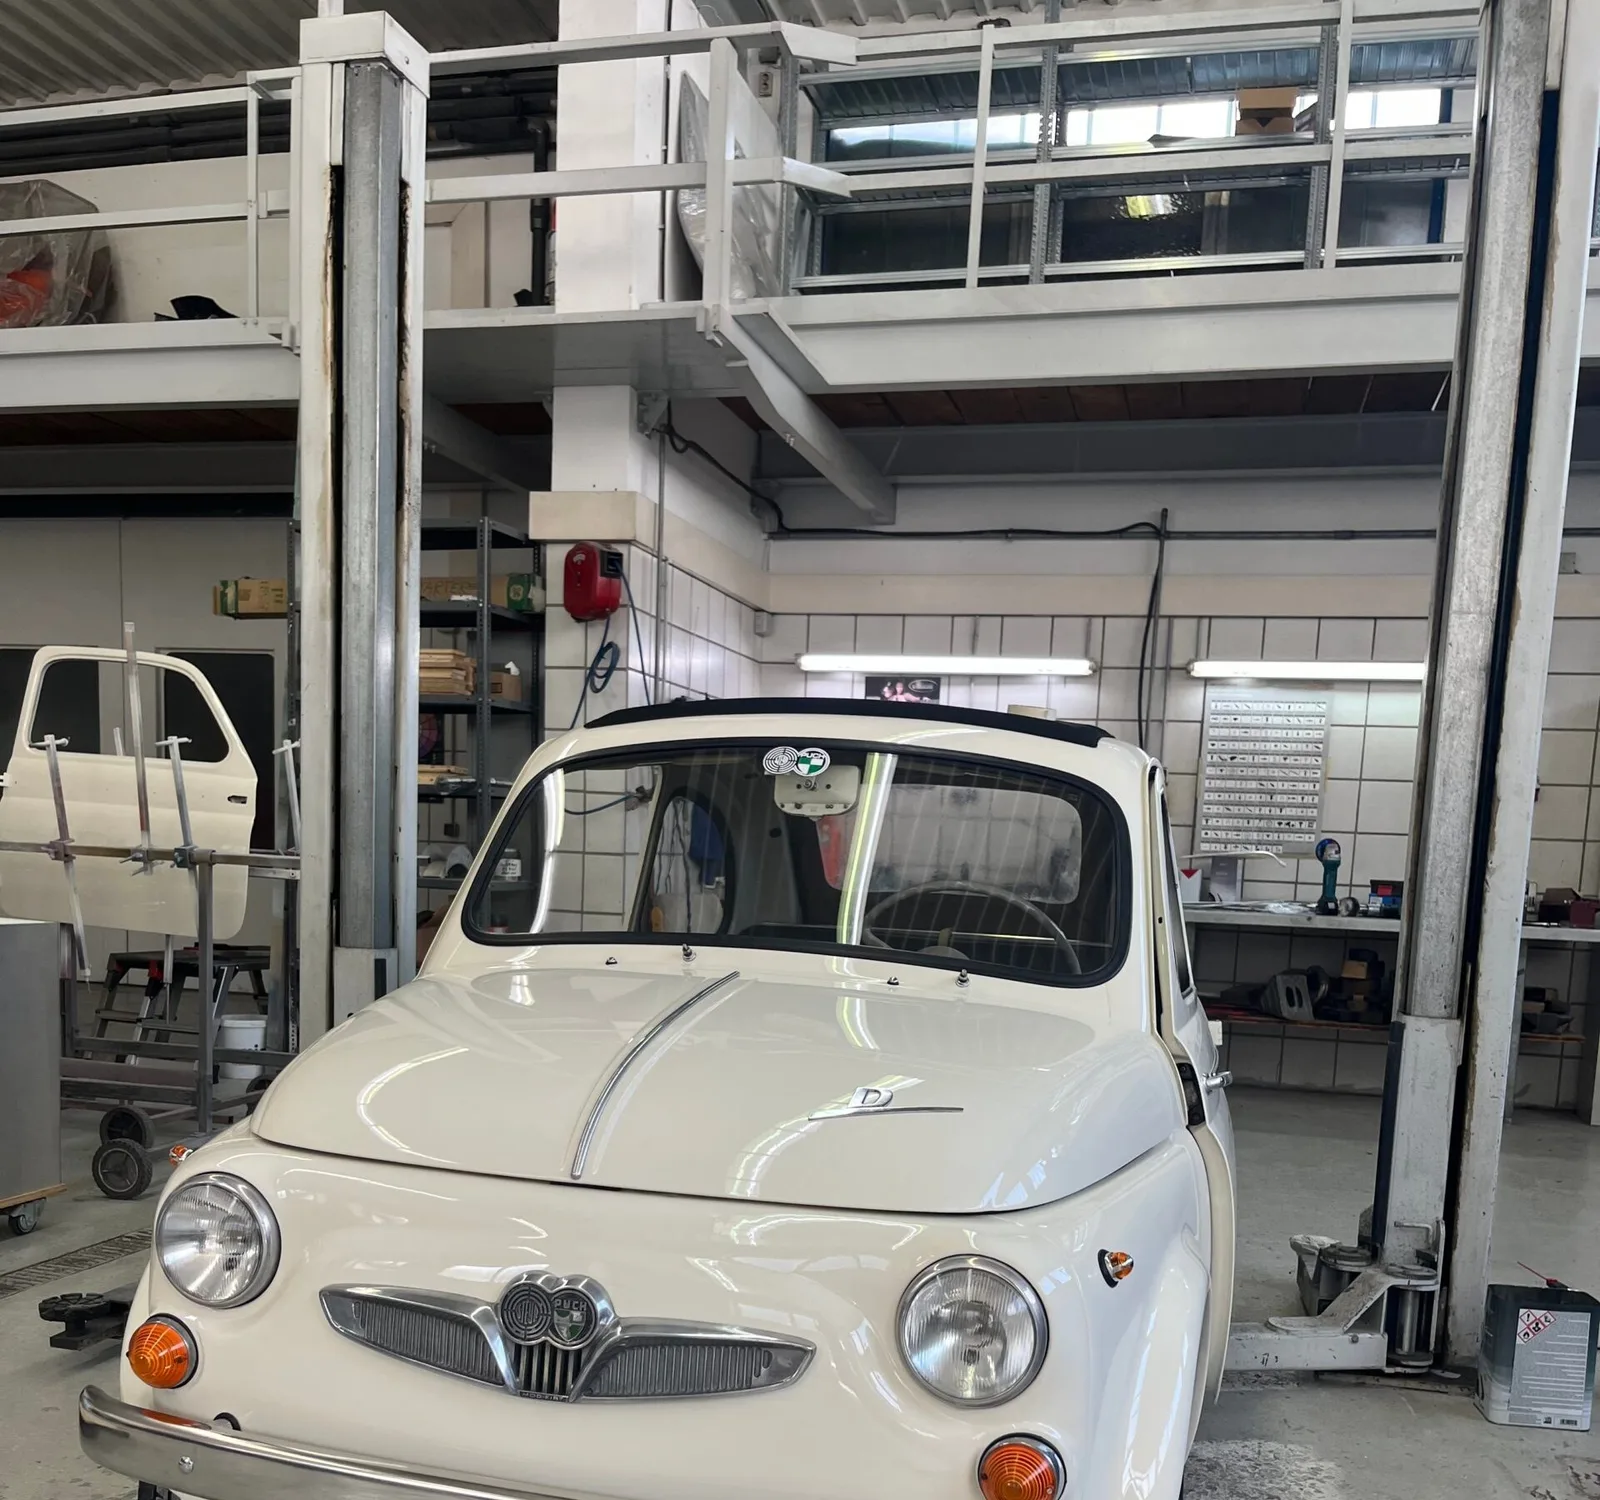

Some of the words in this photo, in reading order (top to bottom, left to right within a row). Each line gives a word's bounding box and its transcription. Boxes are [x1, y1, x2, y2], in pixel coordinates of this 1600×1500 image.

[422, 579, 471, 597] ARTER
[799, 752, 826, 760] PUCH
[848, 1087, 893, 1108] D
[554, 1298, 587, 1311] PUCH
